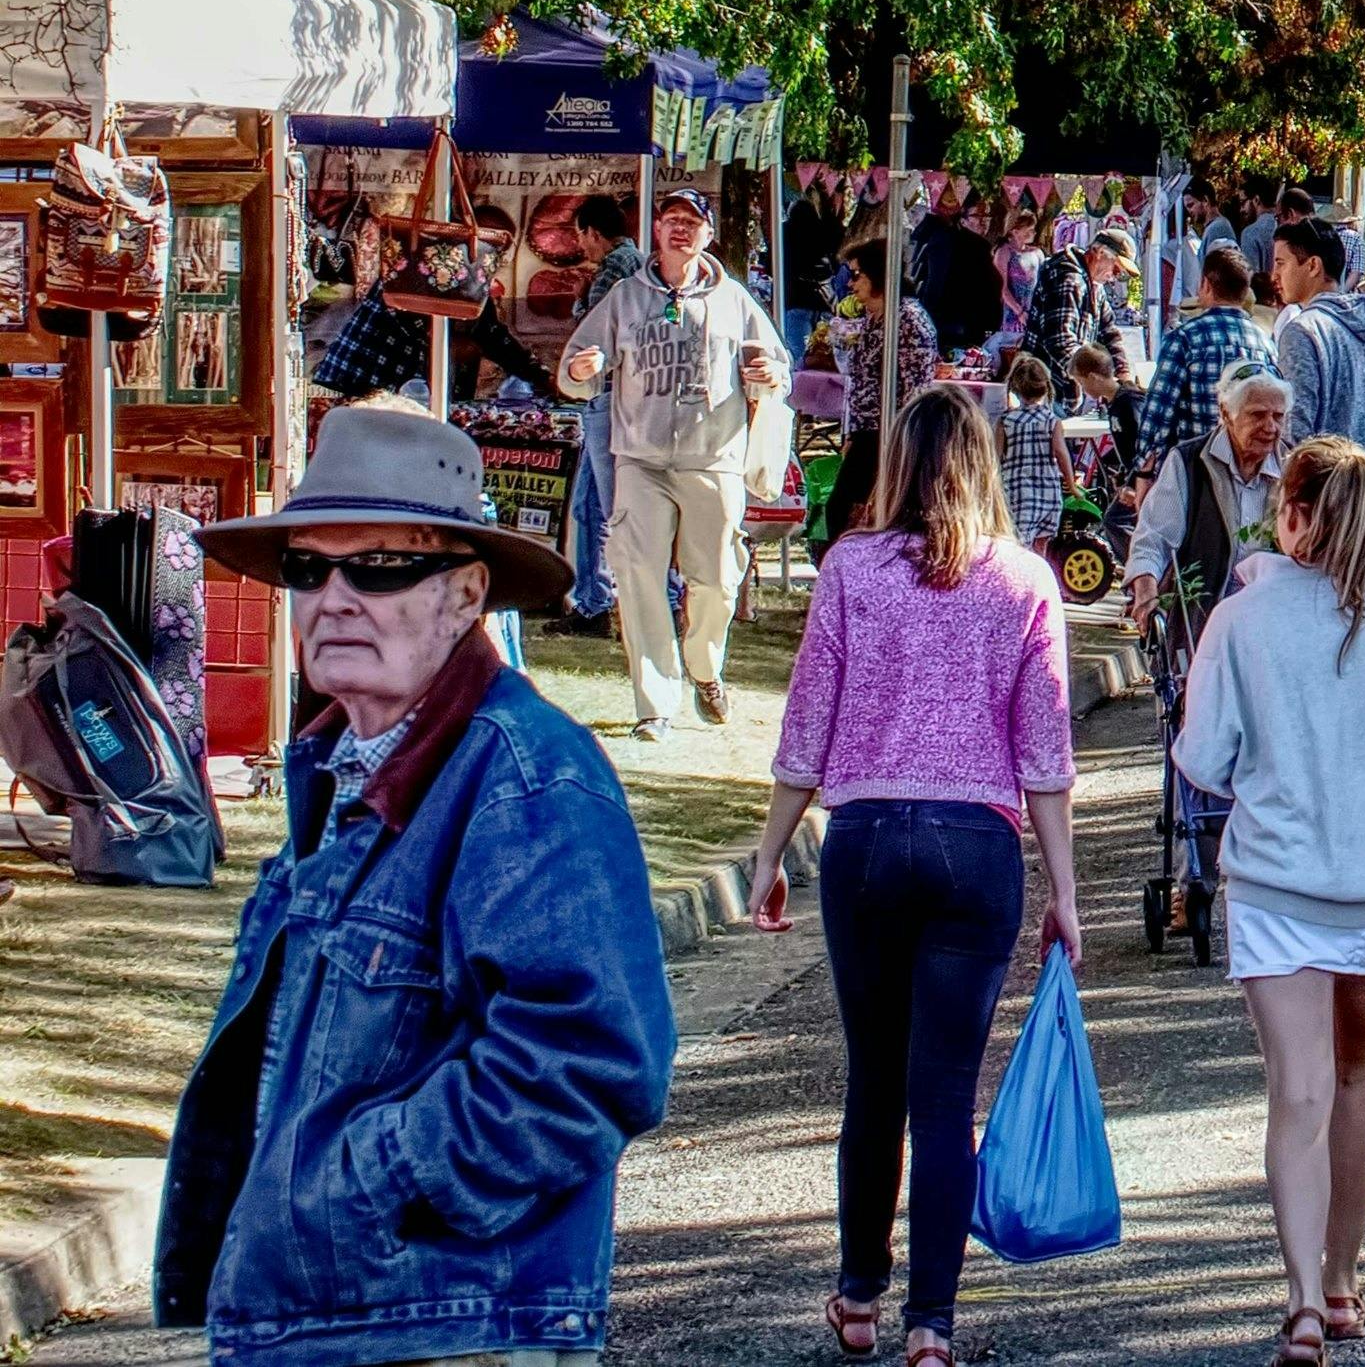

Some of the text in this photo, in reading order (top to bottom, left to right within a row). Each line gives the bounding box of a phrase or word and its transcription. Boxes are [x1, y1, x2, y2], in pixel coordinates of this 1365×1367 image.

[541, 171, 583, 187] AND
[585, 167, 694, 187] SURRNDS
[482, 446, 562, 470] pperoni
[505, 474, 557, 493] VALLEY
